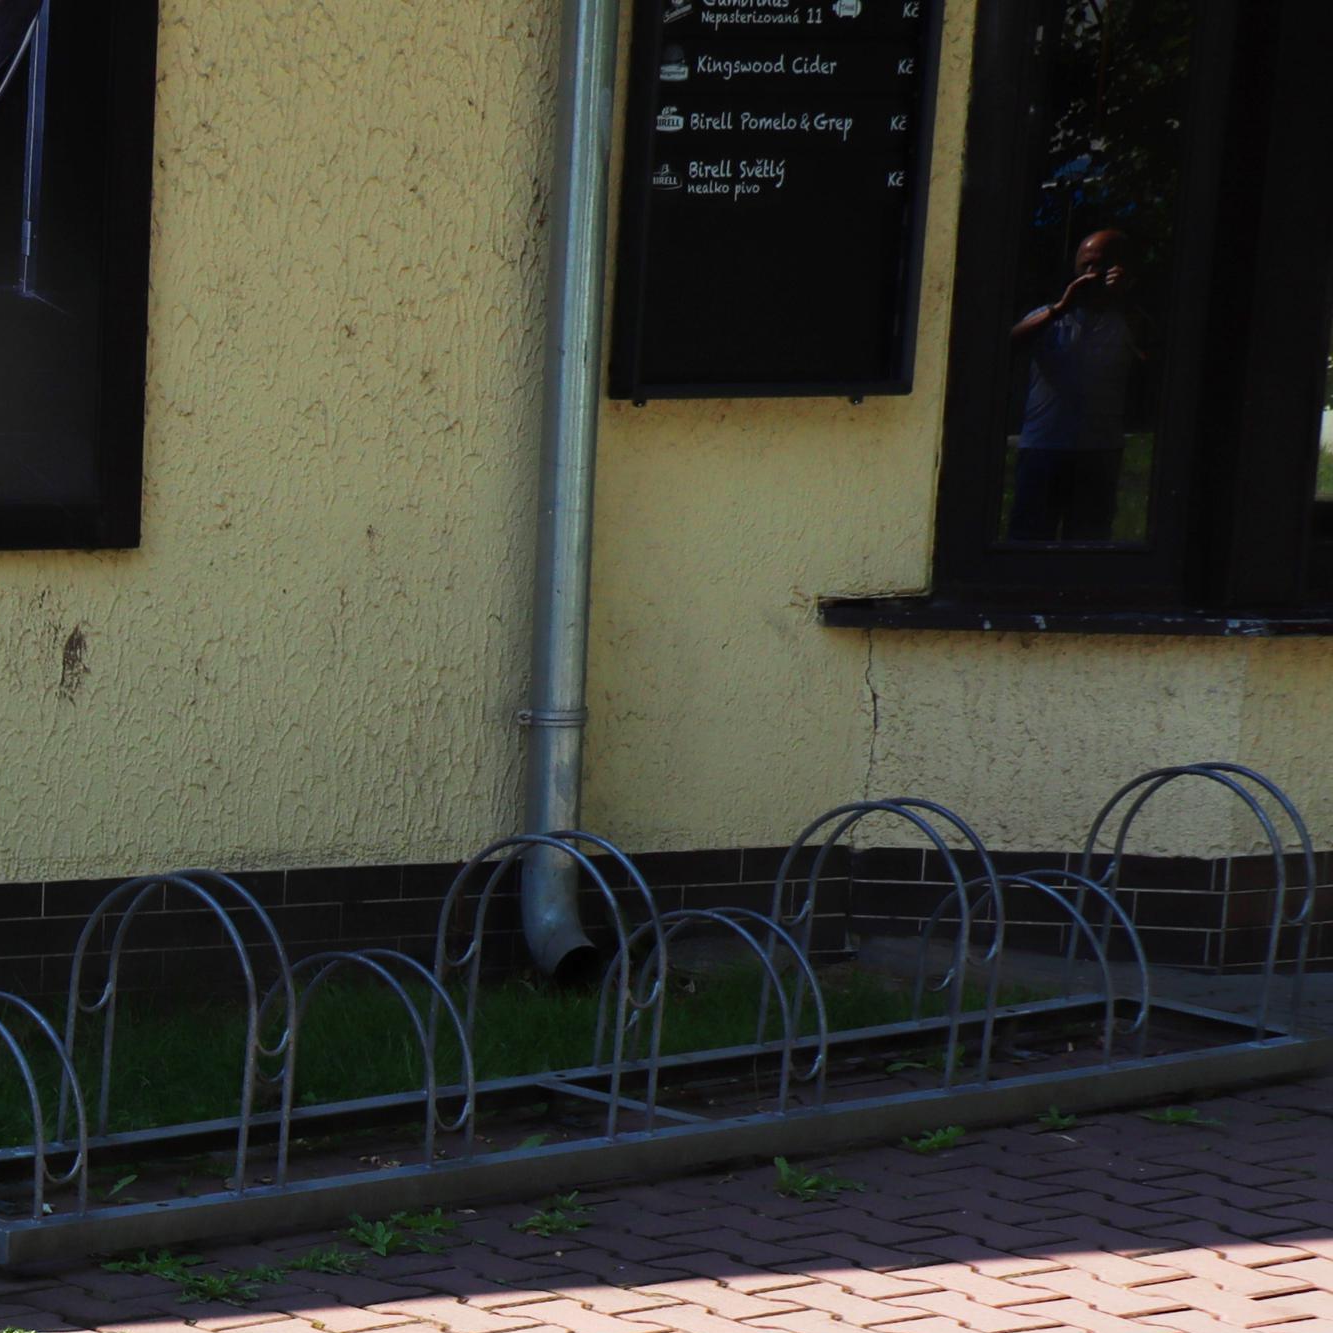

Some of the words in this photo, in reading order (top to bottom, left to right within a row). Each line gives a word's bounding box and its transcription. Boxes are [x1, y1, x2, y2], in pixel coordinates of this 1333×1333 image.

[701, 8, 799, 31] Nepasterizovaná
[806, 8, 822, 24] 11
[902, 3, 919, 18] Kč
[696, 54, 785, 80] Kingswood
[791, 54, 837, 75] Cider
[897, 59, 914, 74] Kč
[690, 112, 732, 131] Birell
[890, 115, 907, 131] Kč
[688, 160, 732, 178] Birell
[739, 159, 785, 188] Světlý
[887, 171, 905, 187] Kč
[687, 181, 730, 194] nealko
[734, 182, 760, 201] pivo
